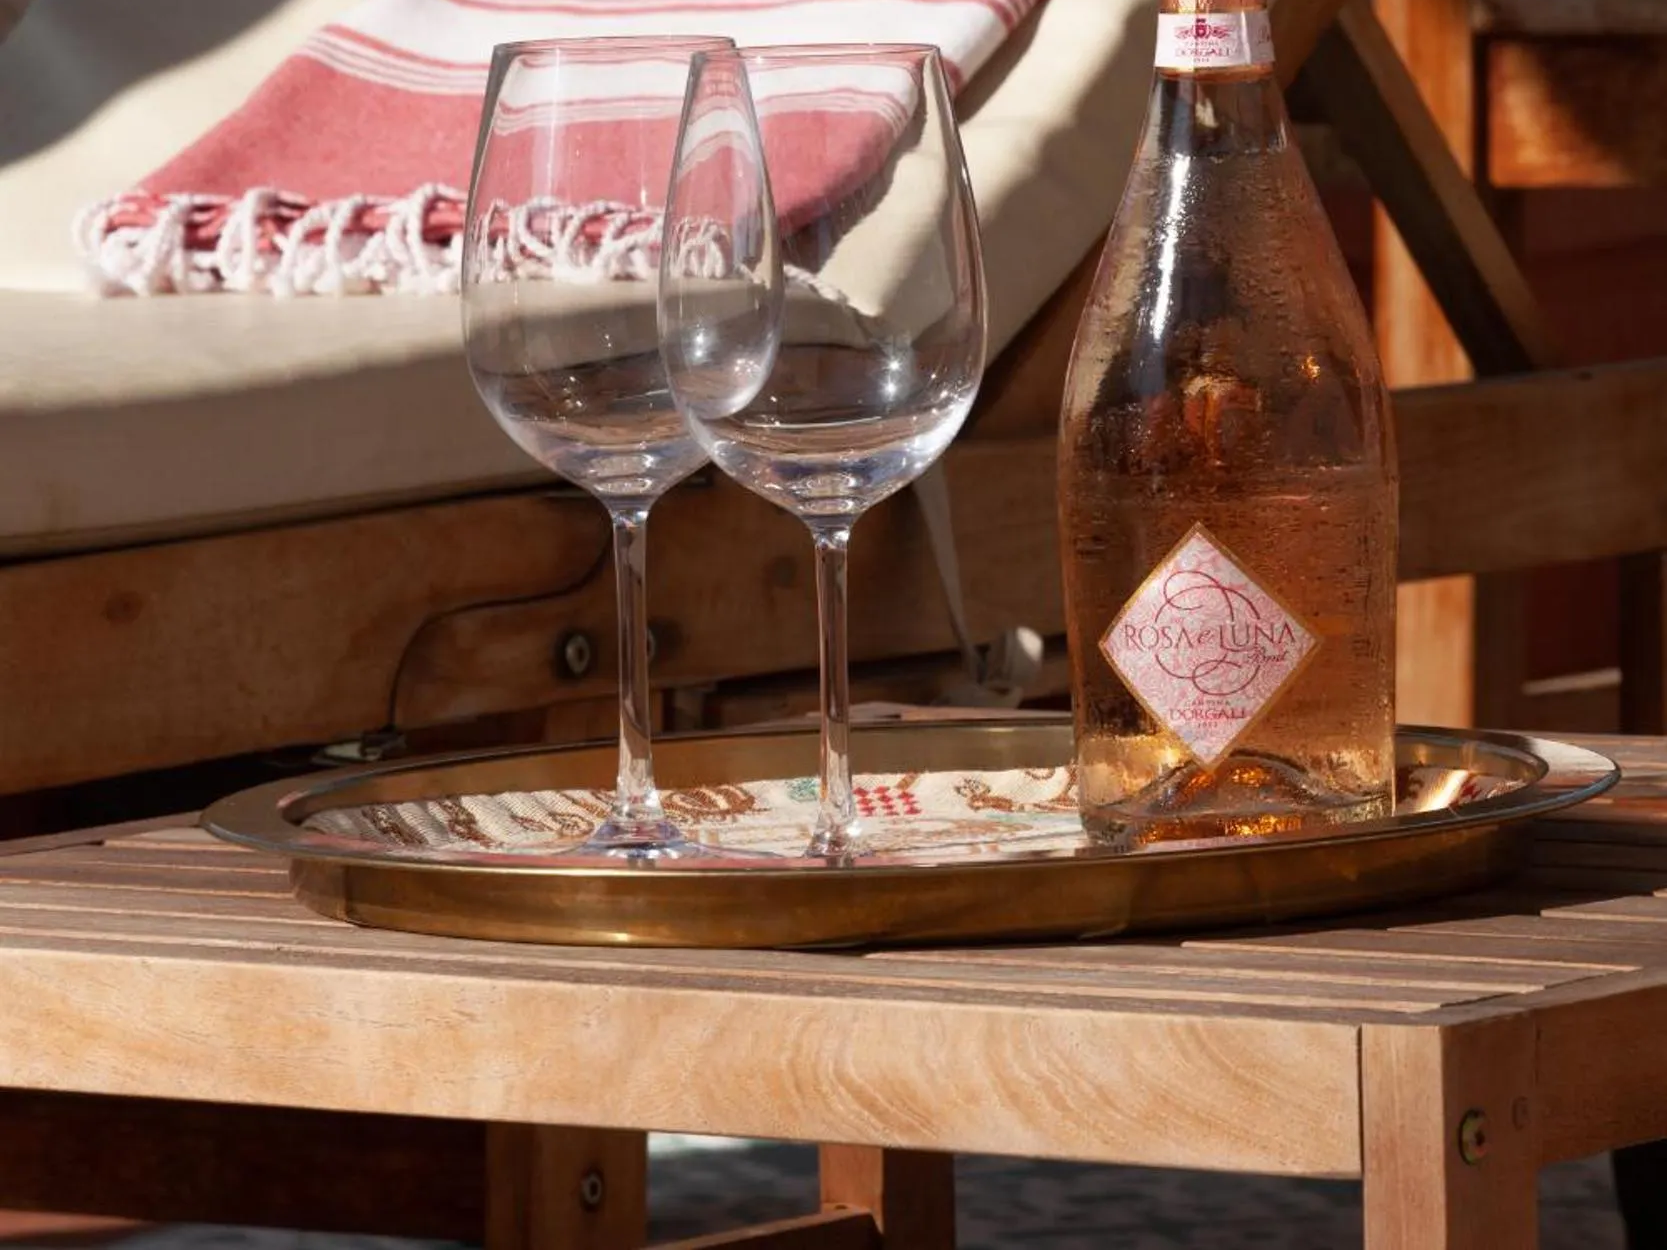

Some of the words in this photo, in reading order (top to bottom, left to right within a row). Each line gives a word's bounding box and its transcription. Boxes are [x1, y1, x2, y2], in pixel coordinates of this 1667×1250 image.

[1124, 624, 1195, 652] ROSA
[1219, 621, 1296, 652] LUNA
[1169, 707, 1247, 722] DORGALI
